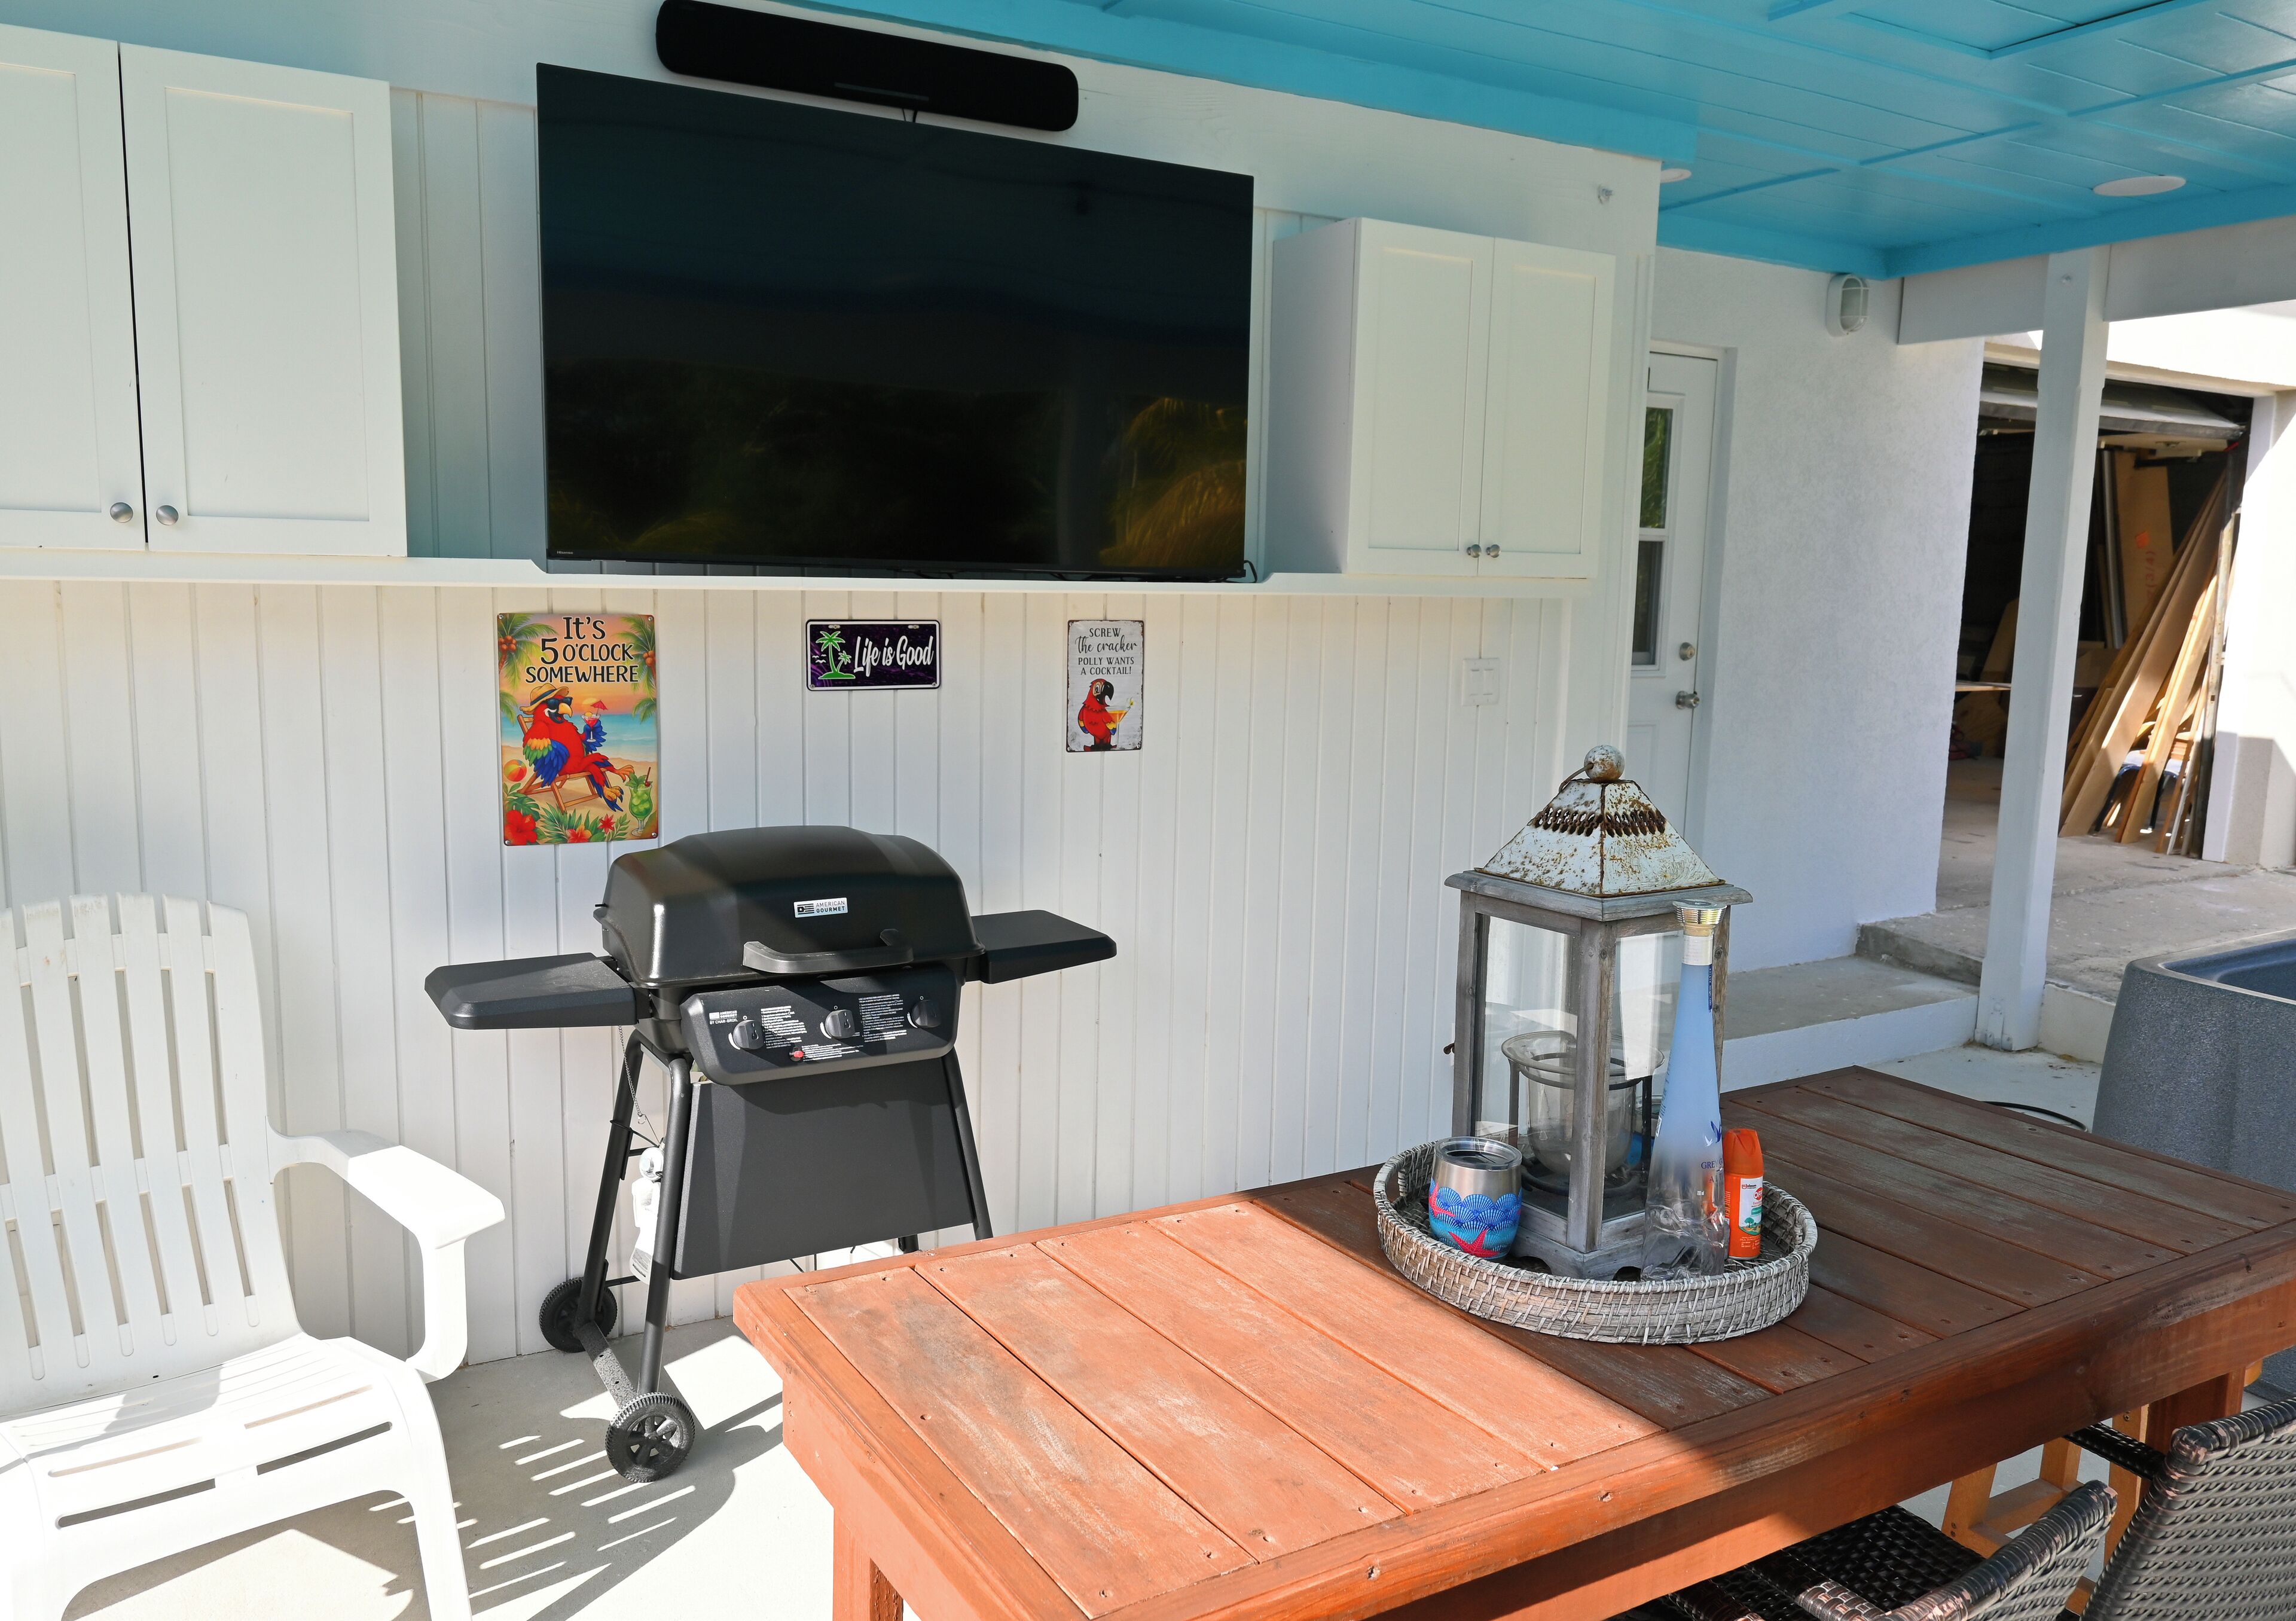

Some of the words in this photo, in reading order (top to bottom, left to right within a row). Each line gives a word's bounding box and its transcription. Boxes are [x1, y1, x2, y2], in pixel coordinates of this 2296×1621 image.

[563, 616, 606, 640] It's
[1089, 628, 1121, 637] SCREW
[541, 637, 558, 665] 5
[563, 643, 634, 663] O'CLOCK
[1075, 636, 1094, 654] the
[1097, 634, 1138, 652] cracker
[853, 636, 881, 677] Life
[882, 637, 895, 666] is
[897, 636, 934, 670] Good
[1078, 657, 1103, 666] POLLY
[1106, 657, 1134, 665] WANTS
[525, 665, 639, 683] SOMEWHERE
[1089, 666, 1132, 675] COCKTAIL!
